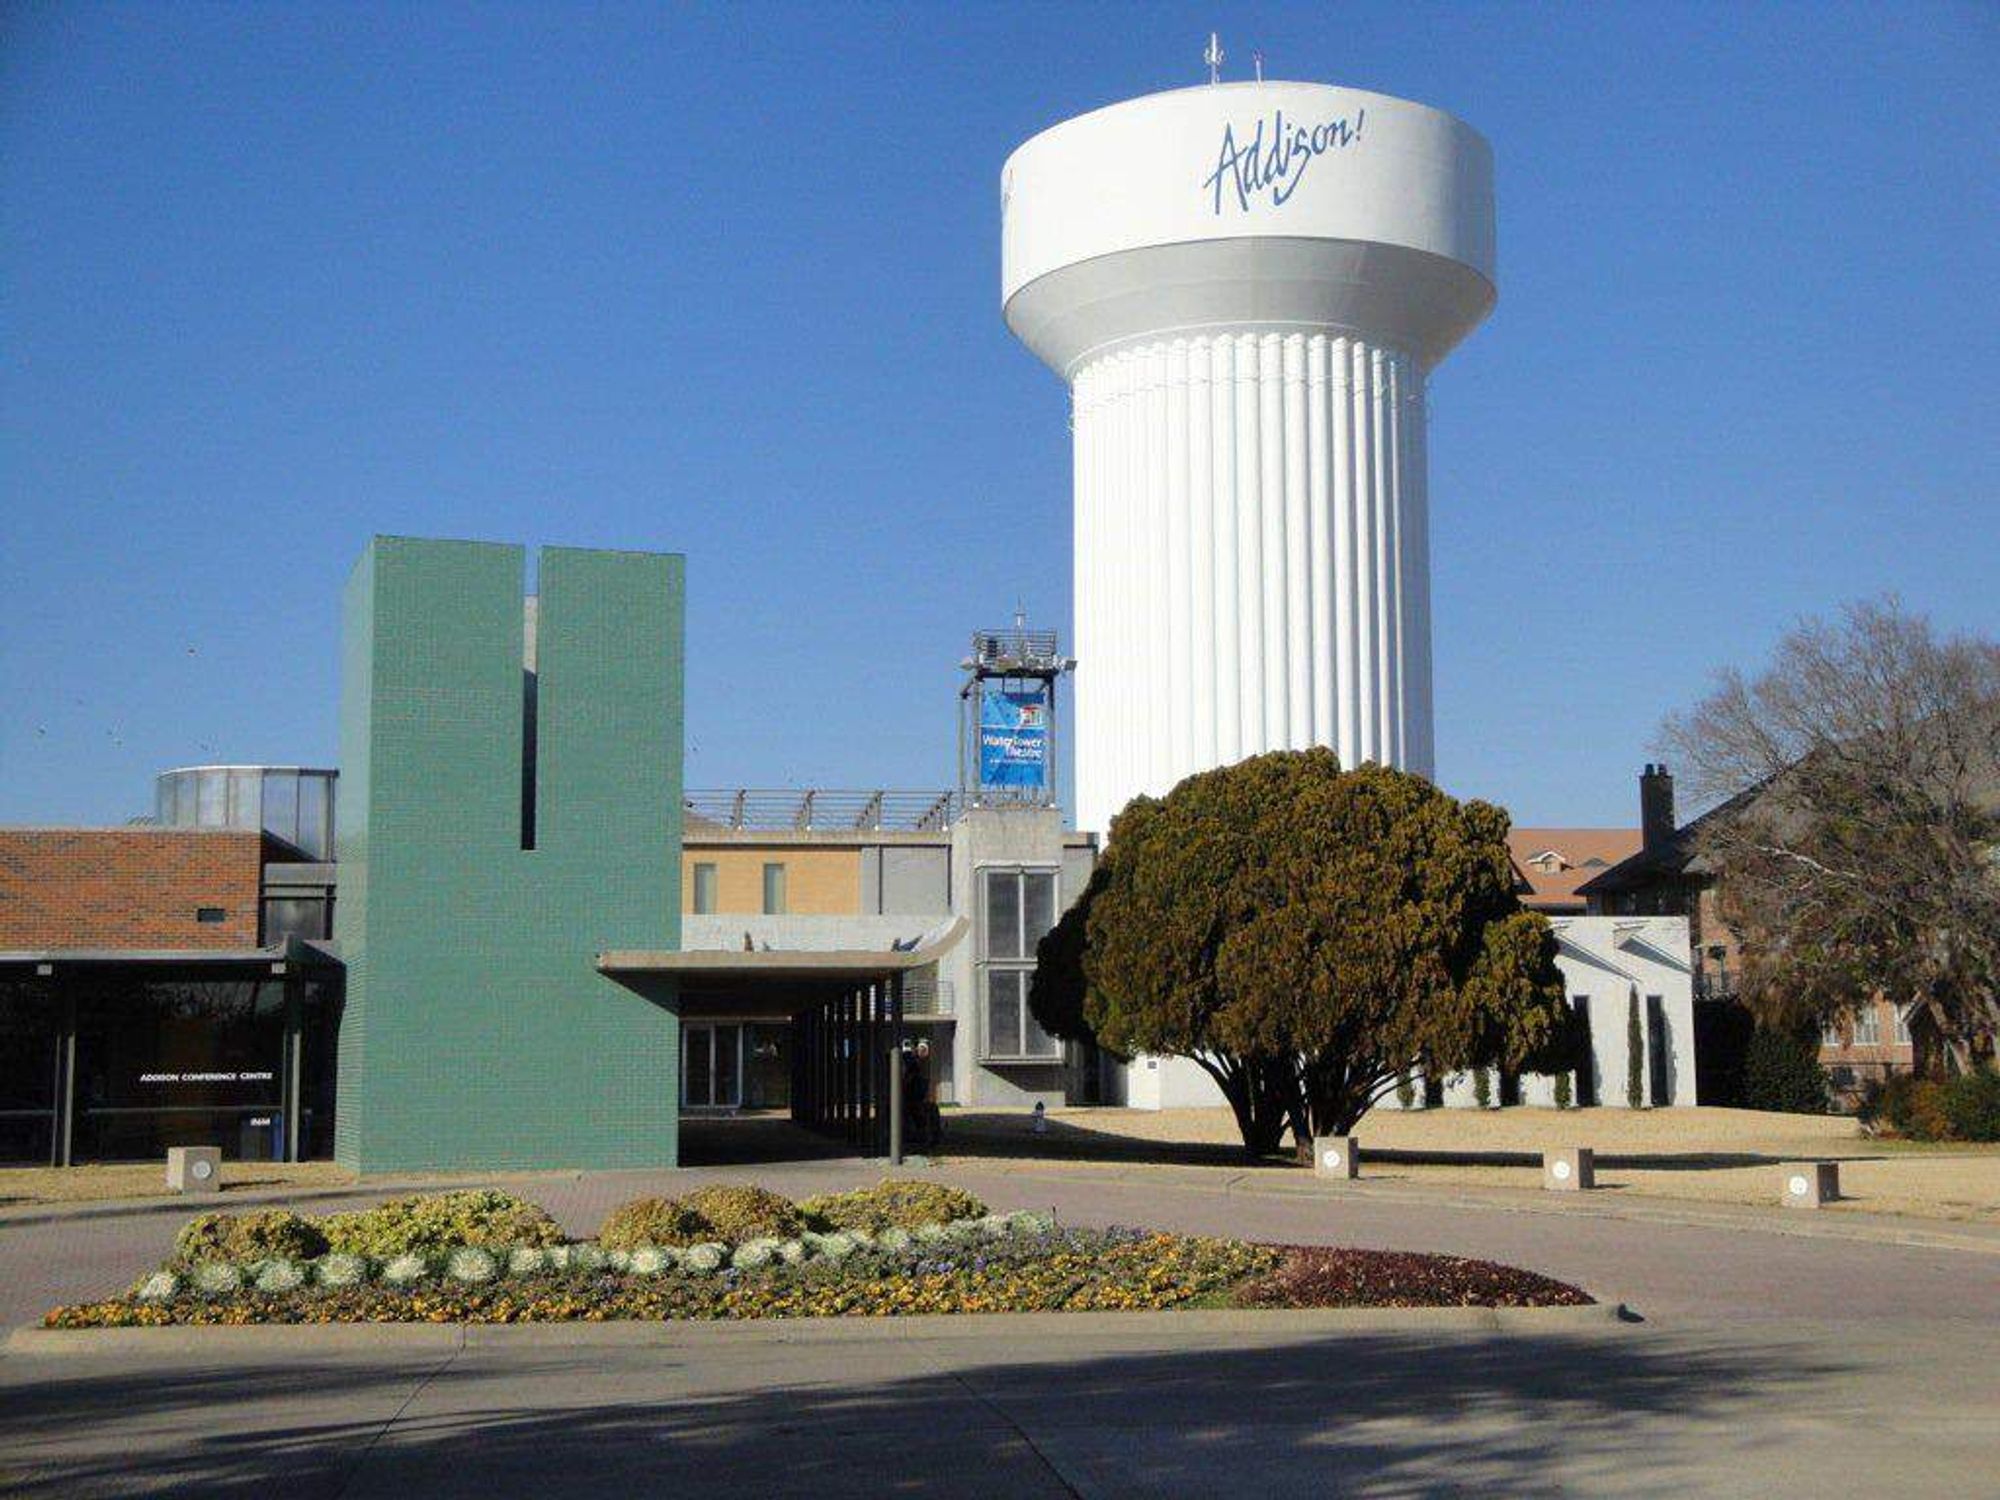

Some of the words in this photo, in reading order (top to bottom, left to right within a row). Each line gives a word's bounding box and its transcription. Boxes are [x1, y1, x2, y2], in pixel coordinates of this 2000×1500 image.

[1203, 109, 1365, 215] Addison!
[181, 1073, 237, 1081] CONFERENCE
[239, 1072, 272, 1080] CENTRE
